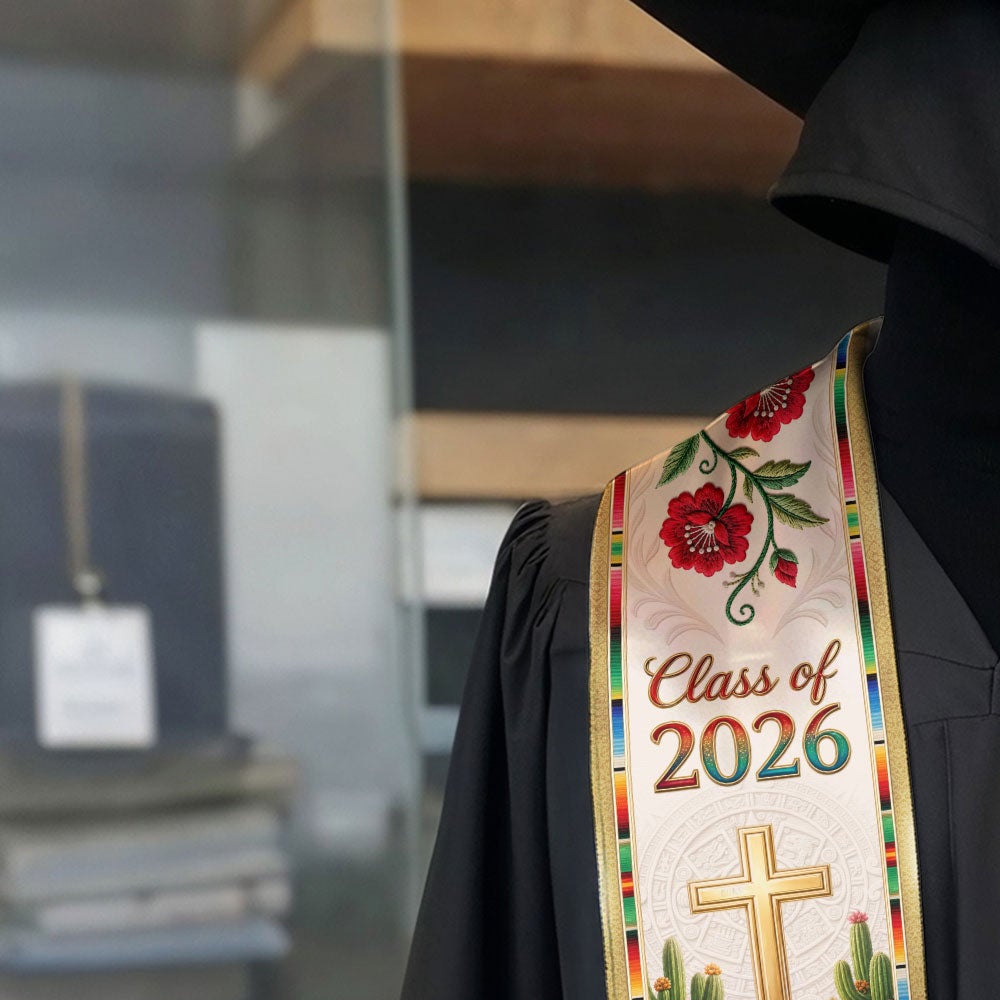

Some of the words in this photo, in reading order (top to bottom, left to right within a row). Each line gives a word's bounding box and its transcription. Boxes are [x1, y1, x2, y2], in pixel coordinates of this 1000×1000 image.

[644, 651, 780, 709] Class
[789, 638, 841, 705] of
[650, 702, 851, 793] 2026
